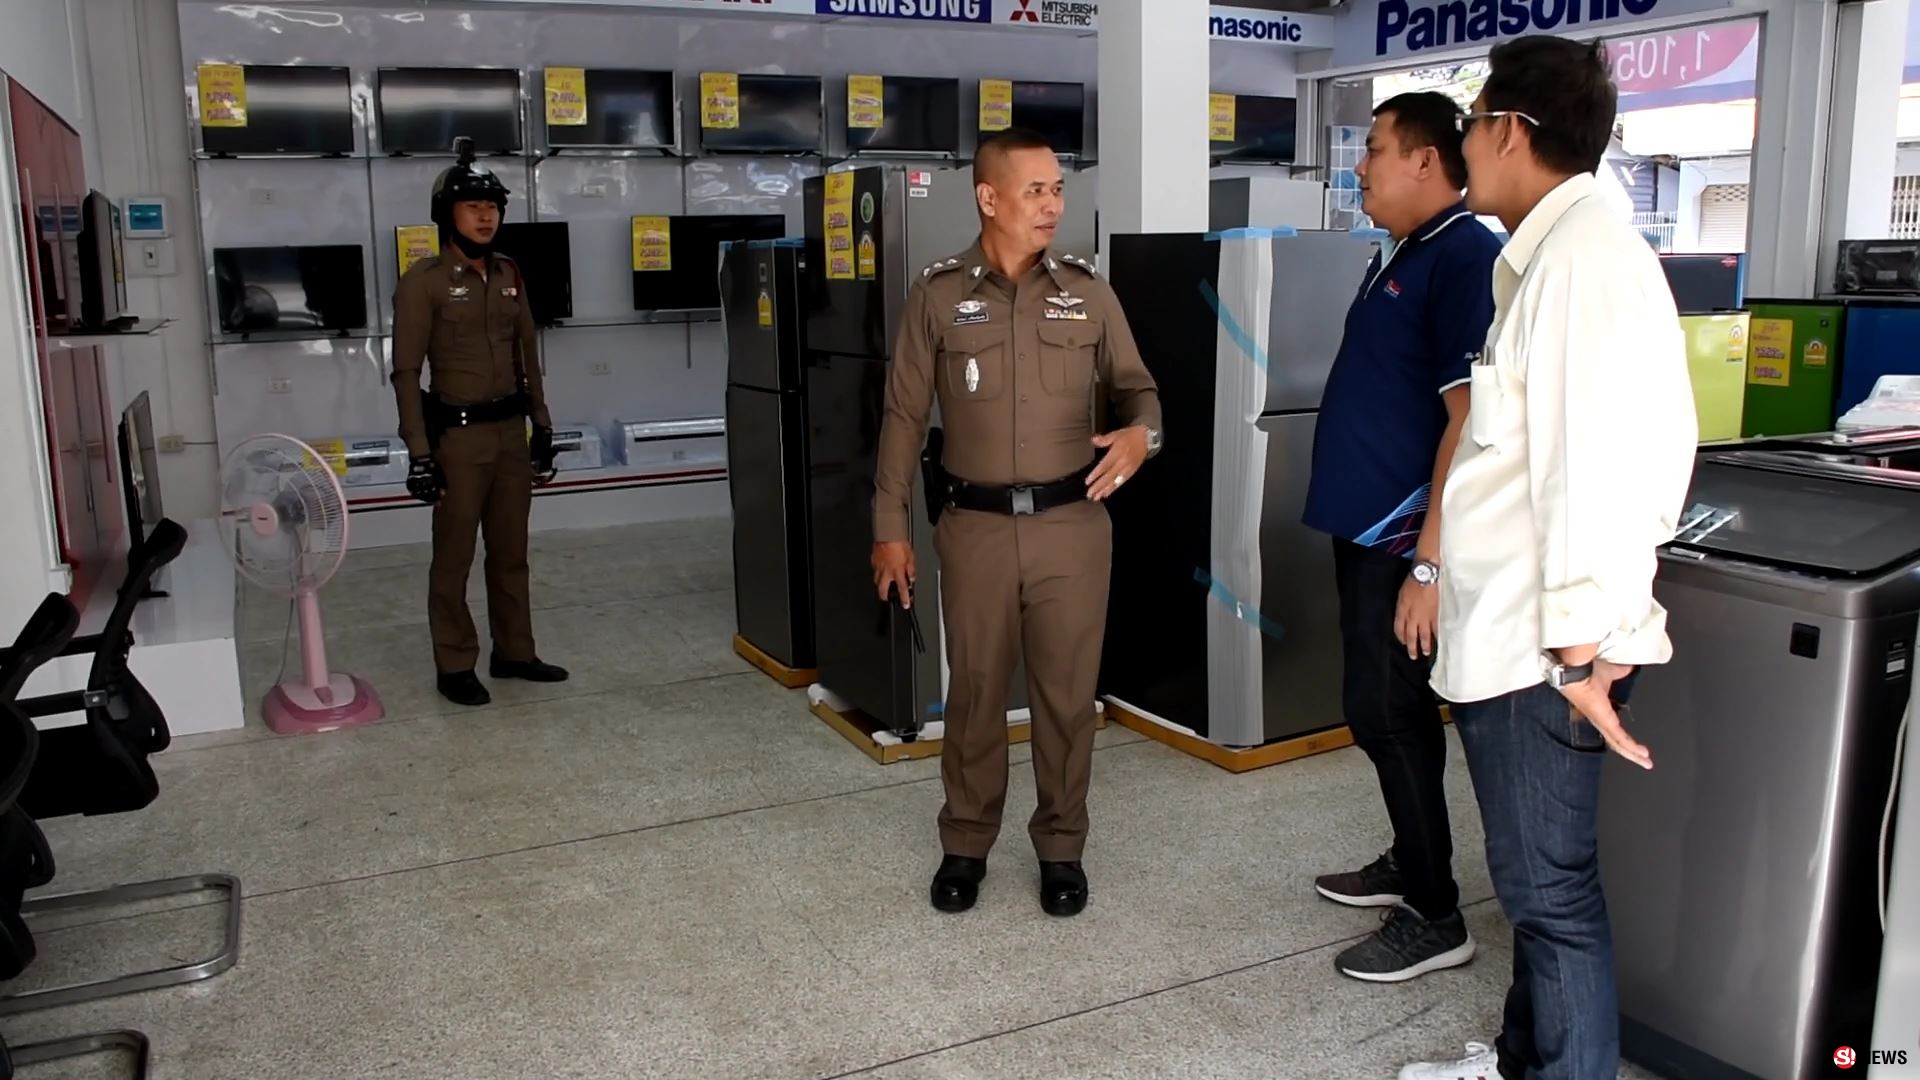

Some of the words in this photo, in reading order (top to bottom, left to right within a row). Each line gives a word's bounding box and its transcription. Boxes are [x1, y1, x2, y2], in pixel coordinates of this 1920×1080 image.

[829, 0, 980, 19] SAMSUNG
[1041, 0, 1098, 15] MITSUBISH
[1041, 12, 1092, 26] ELECTRIC
[1209, 16, 1301, 42] nasonic
